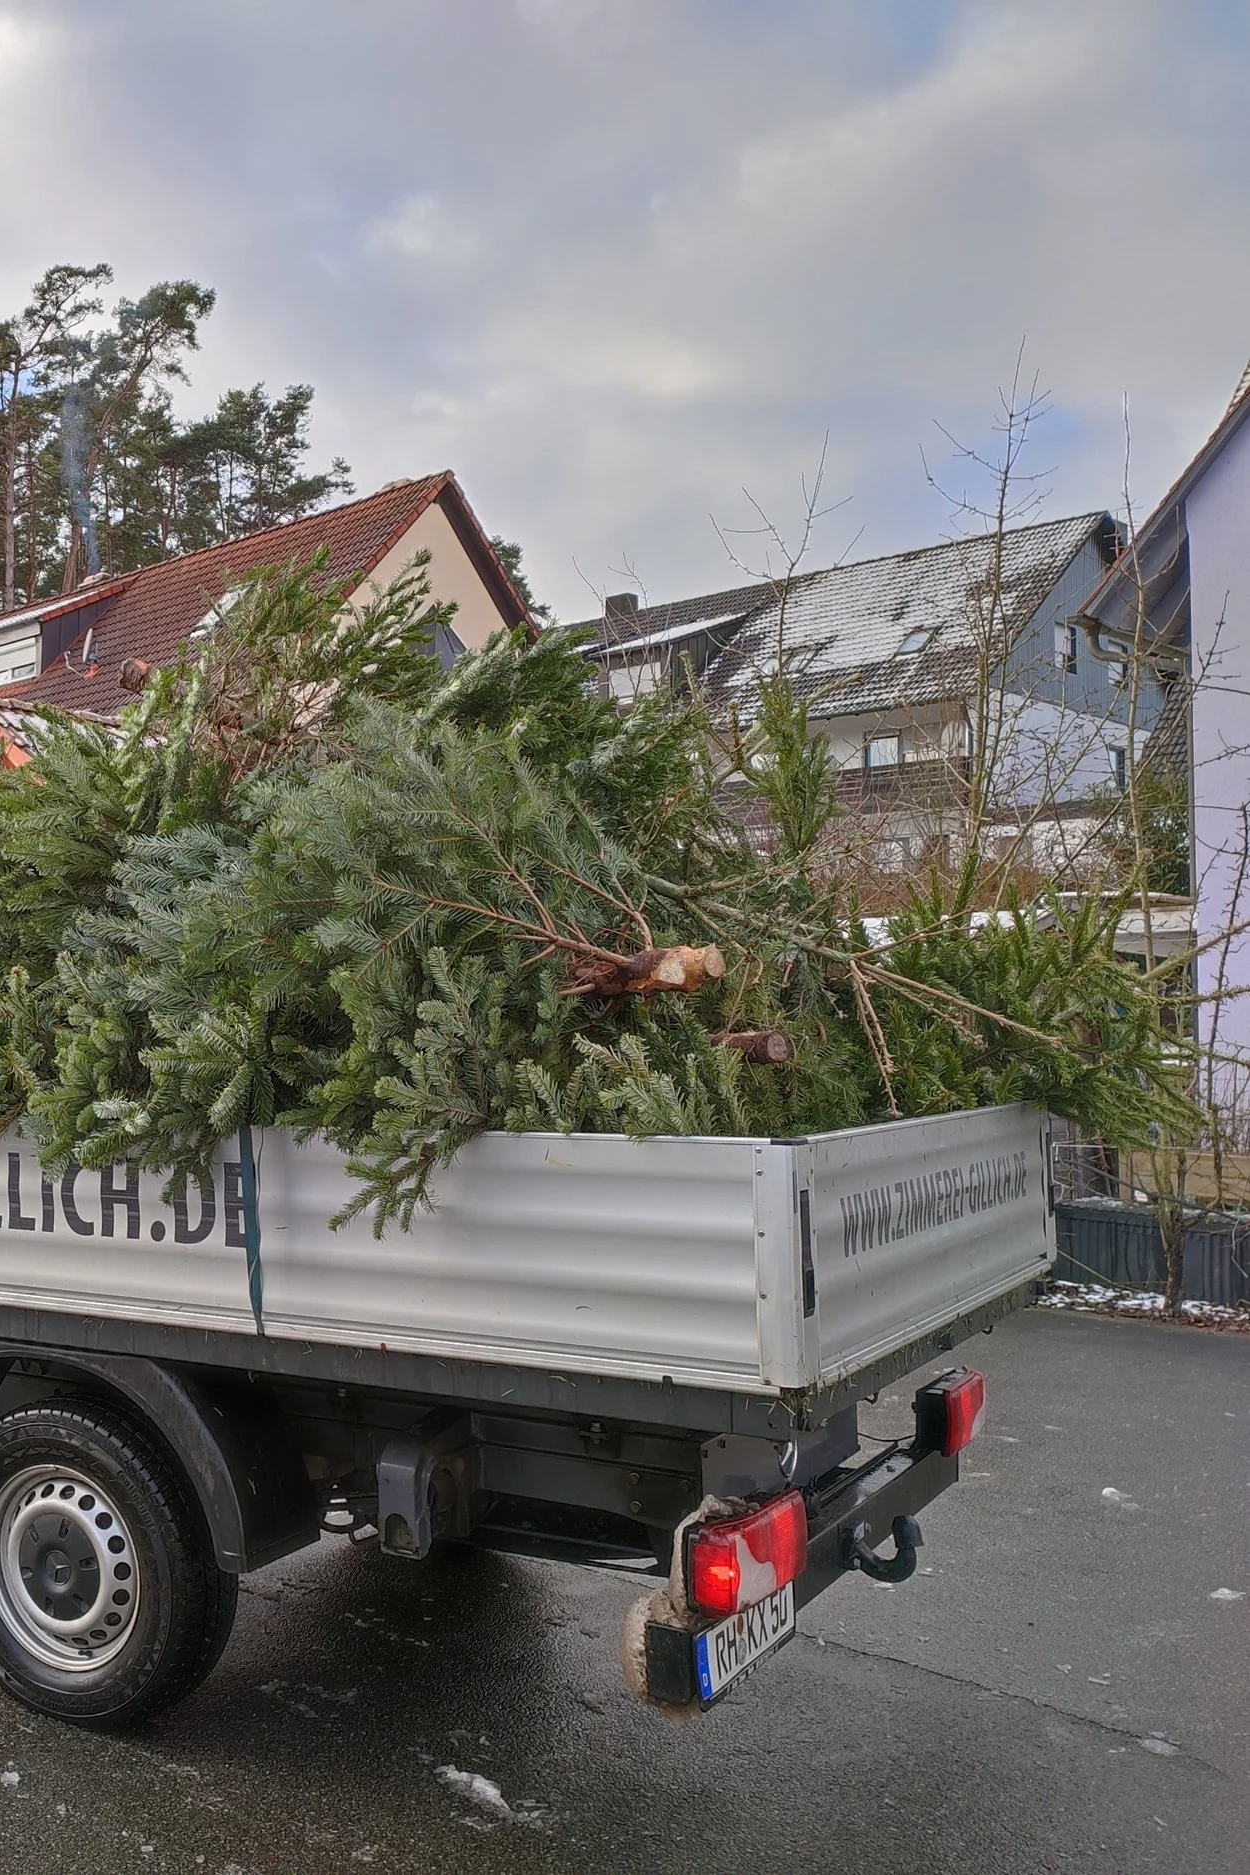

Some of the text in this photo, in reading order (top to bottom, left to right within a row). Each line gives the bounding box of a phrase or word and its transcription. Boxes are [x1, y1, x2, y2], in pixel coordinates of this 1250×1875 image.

[839, 1151, 1027, 1258] WWW.ZIMMEREI-GILLICH.DE
[715, 1620, 739, 1680] RH
[745, 1600, 768, 1654] KX
